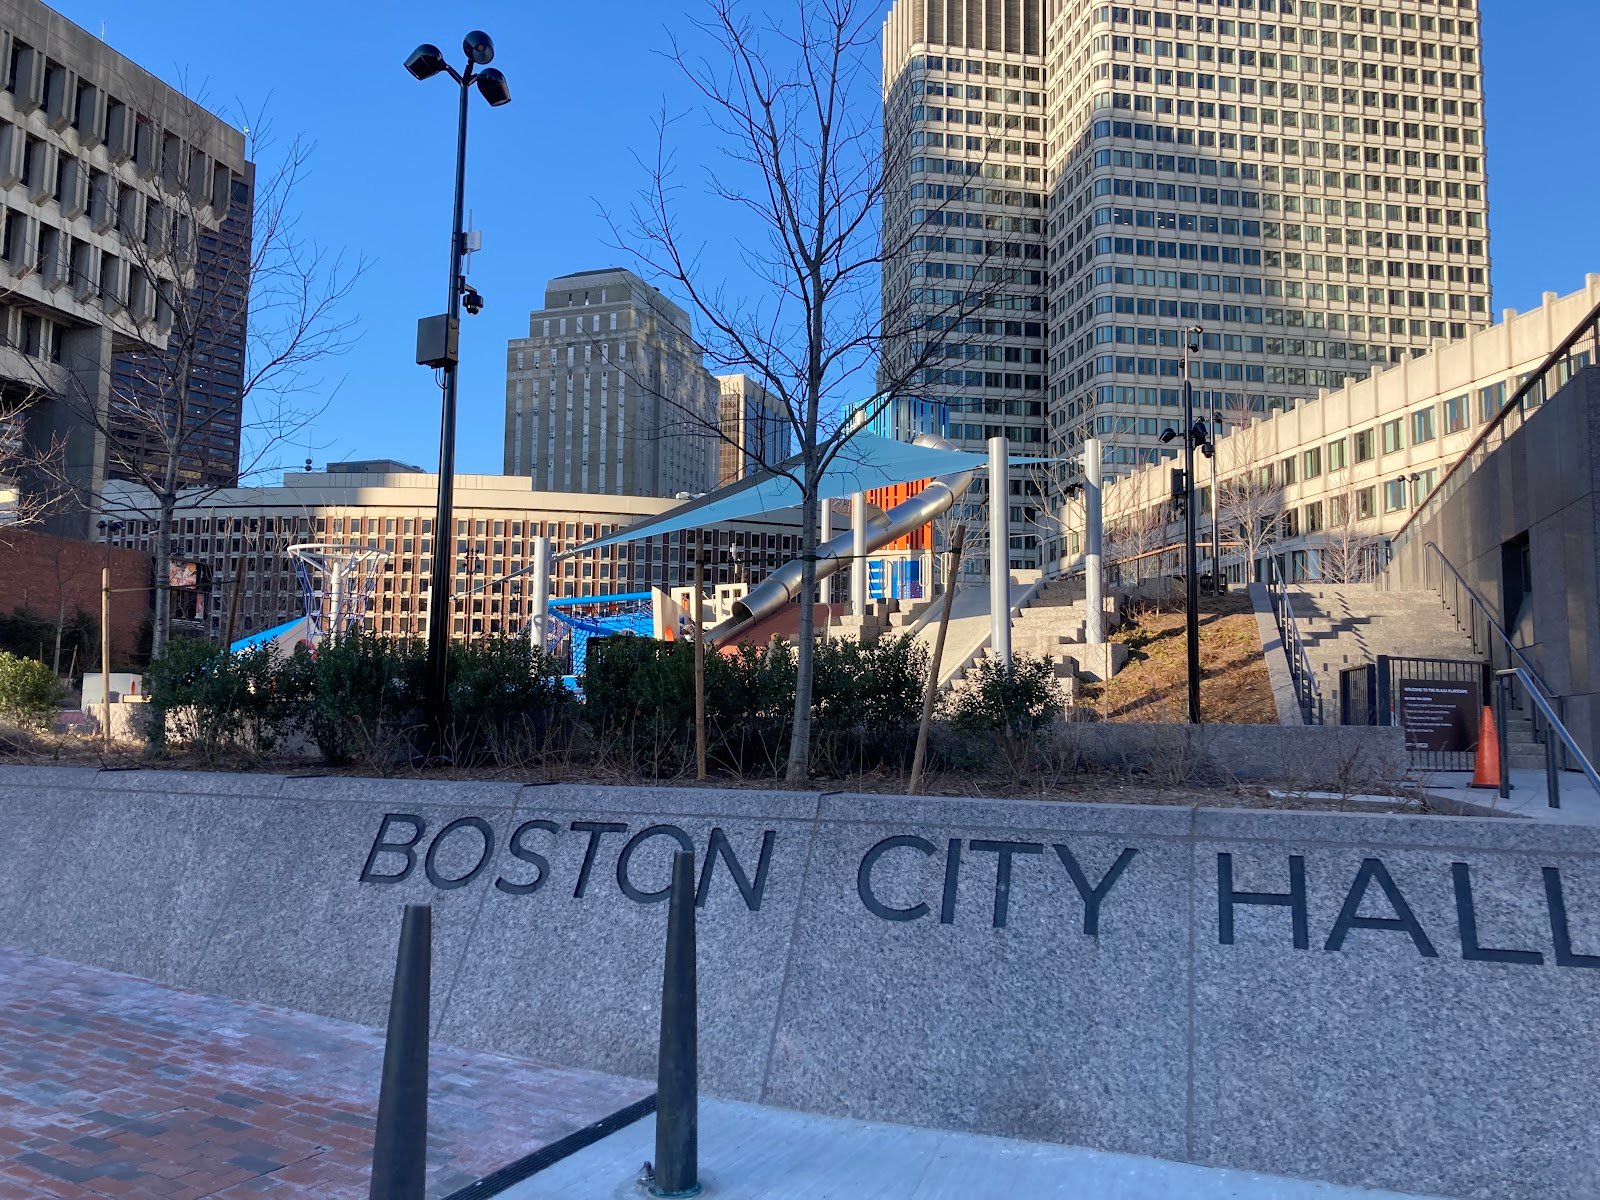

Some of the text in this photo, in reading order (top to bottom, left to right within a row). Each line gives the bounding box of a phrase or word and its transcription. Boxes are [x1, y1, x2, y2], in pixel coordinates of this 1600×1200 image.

[359, 813, 1600, 968] BOSTON CITY HALL
